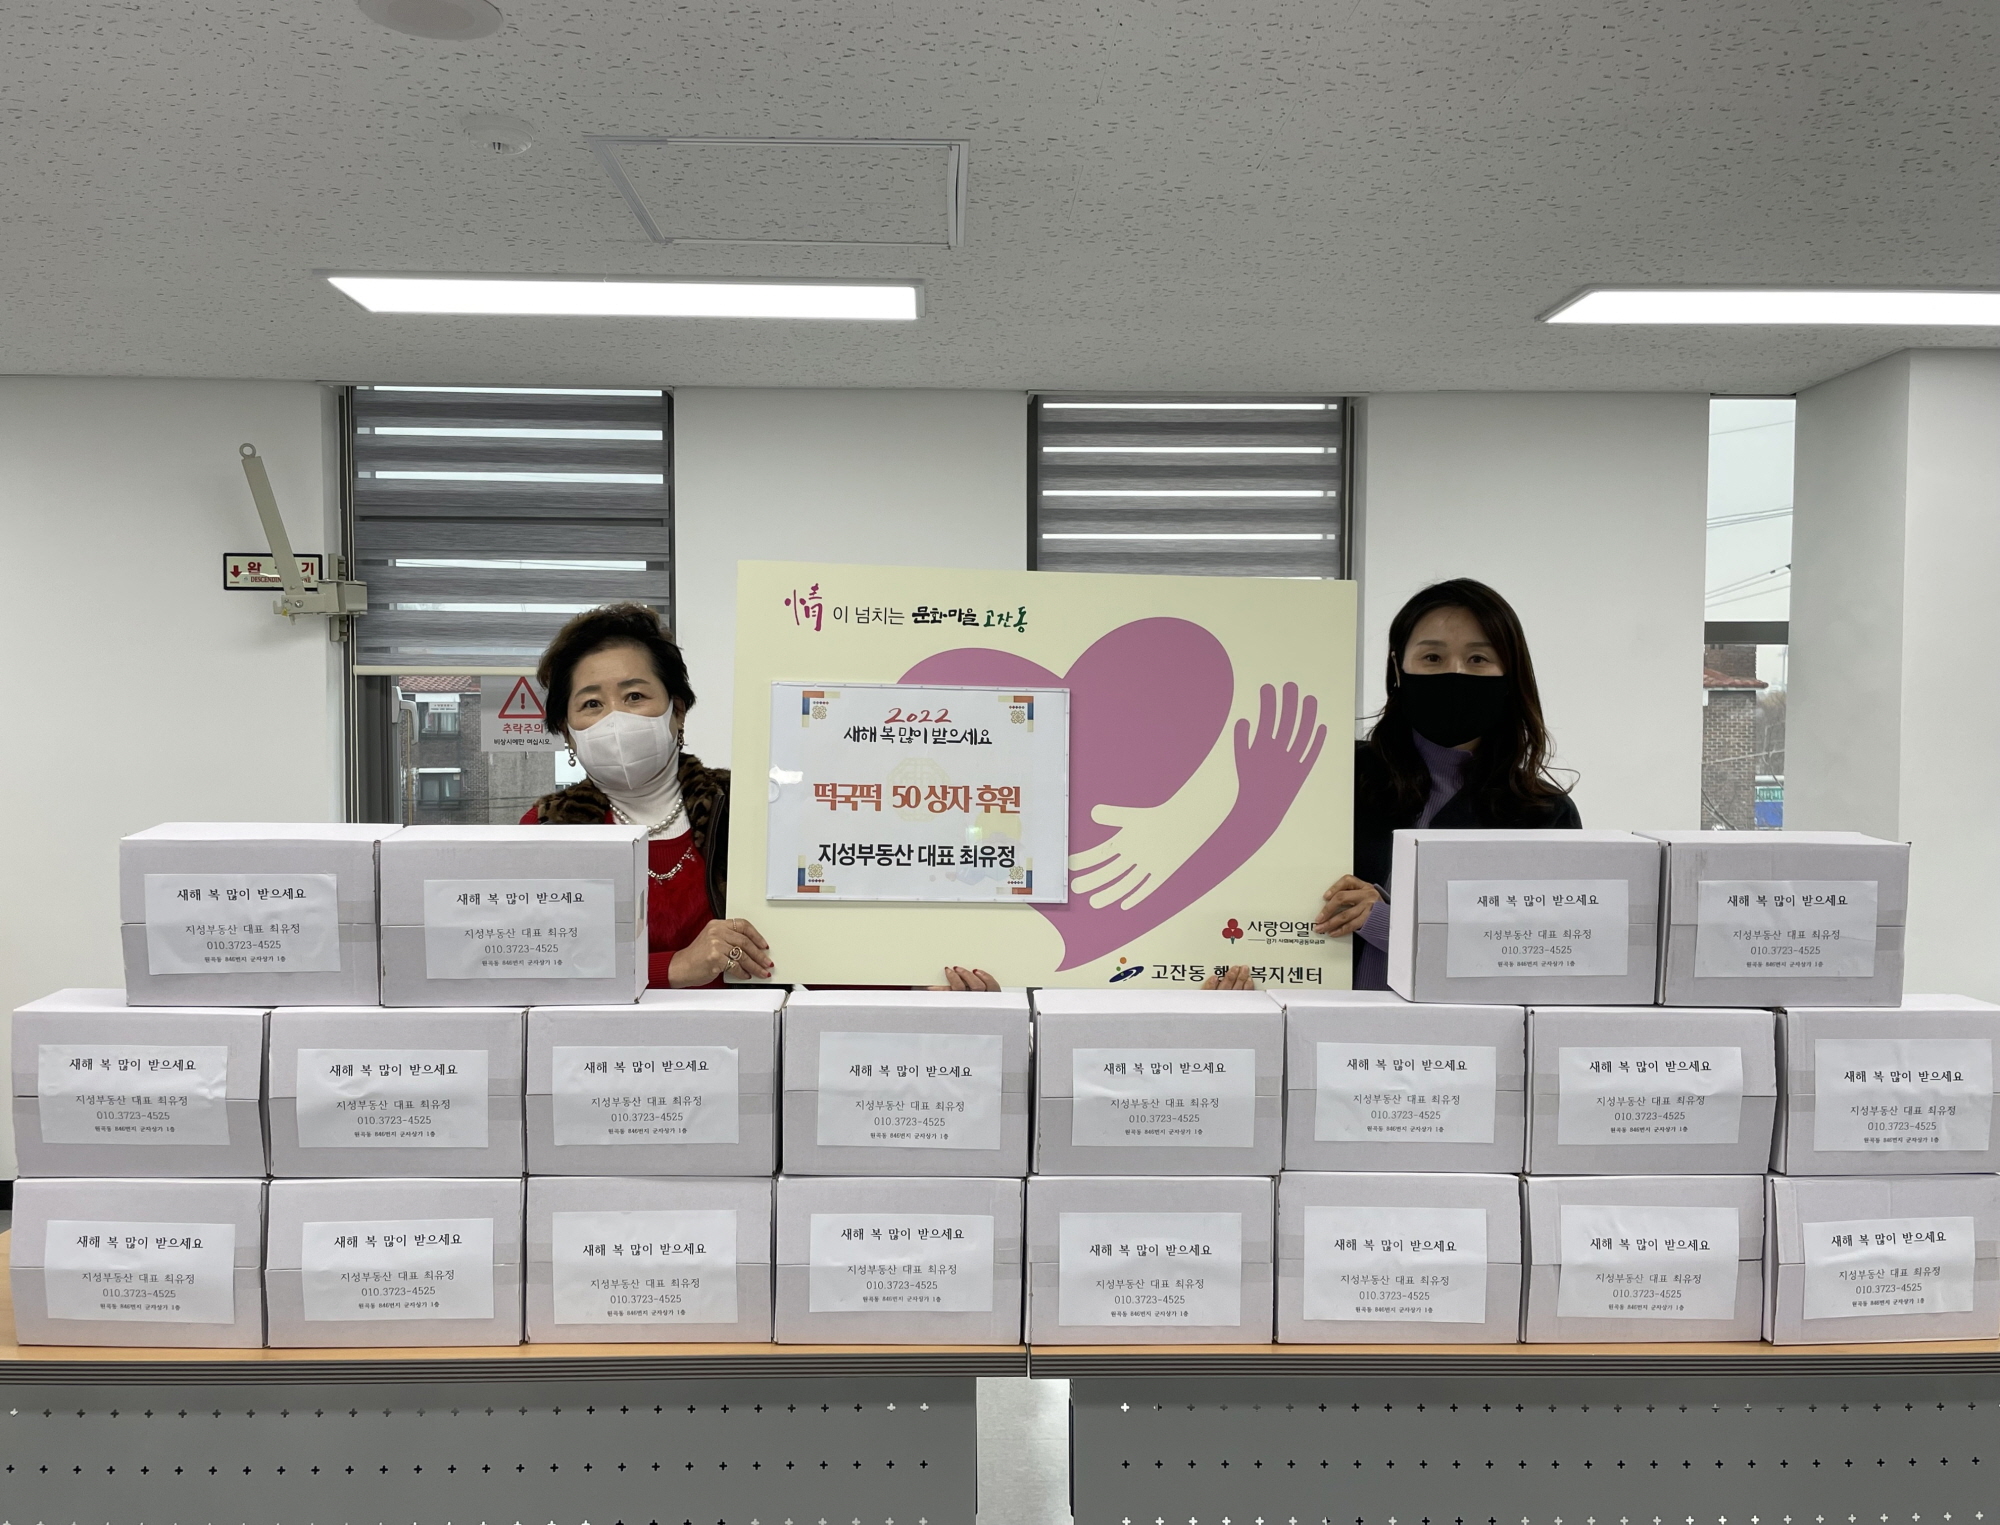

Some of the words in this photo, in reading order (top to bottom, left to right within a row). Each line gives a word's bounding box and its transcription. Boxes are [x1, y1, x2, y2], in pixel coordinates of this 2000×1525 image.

[833, 605, 848, 624] 이
[855, 605, 905, 625] 넘치는
[983, 606, 1028, 633] 고잔동
[884, 707, 953, 724] 2022
[502, 723, 544, 734] 추락주의
[843, 725, 877, 743] 새해
[880, 726, 896, 744] 복
[898, 727, 928, 745] 많이
[931, 727, 993, 746] 받으세요
[493, 738, 525, 746] 비상시에만
[813, 783, 882, 812] 떡국떡
[892, 785, 921, 809] 50
[924, 784, 972, 813] 상자
[975, 785, 1021, 814] 후원
[818, 842, 914, 867] 지성부동산
[918, 845, 955, 867] 대표
[959, 845, 1015, 868] 최유정
[176, 888, 201, 902] 새해
[207, 888, 221, 901] 복
[226, 888, 250, 901] 많이
[257, 887, 307, 901] 받으세요
[1727, 894, 1749, 907] 새해
[1755, 895, 1768, 907] 복
[1774, 894, 1795, 907] 많이
[1802, 894, 1848, 907] 받으세요
[1477, 895, 1500, 908] 새해
[1506, 895, 1518, 907] 복
[1523, 894, 1546, 907] 많이
[1552, 894, 1599, 907] 받으세요
[185, 924, 238, 936] 지성부동산
[243, 923, 264, 934] 대표
[270, 923, 300, 935] 최유정
[464, 928, 516, 940] 지성부동산
[521, 927, 542, 938] 대표
[548, 927, 577, 938] 최유정
[1483, 929, 1533, 941] 지성부동산
[1538, 929, 1558, 940] 대표
[1563, 929, 1591, 940] 최유정
[206, 940, 281, 950] 010.3723-4525
[484, 943, 559, 954] 010.3723-4525
[1501, 945, 1572, 955] 010.3723-4525
[1750, 946, 1821, 955] 010.3723-4525
[1151, 964, 1206, 983] 고잔동
[1213, 965, 1323, 985] 행복지센터
[329, 1064, 353, 1077] 새해
[360, 1064, 373, 1077] 복
[379, 1063, 402, 1077] 많이
[409, 1063, 458, 1076] 받으세요
[583, 1061, 607, 1074] 새해
[613, 1061, 626, 1074] 복
[632, 1060, 655, 1073] 많이
[661, 1059, 709, 1073] 받으세요
[1346, 1058, 1369, 1071] 새해
[1375, 1058, 1387, 1071] 복
[1393, 1058, 1415, 1071] 많이
[1421, 1059, 1468, 1072] 받으세요
[1844, 1070, 1867, 1083] 새해
[1873, 1070, 1885, 1083] 복
[1890, 1070, 1912, 1083] 많이
[1918, 1070, 1964, 1083] 받으세요
[76, 1094, 126, 1106] 지성부동산
[131, 1095, 153, 1106] 대표
[158, 1095, 187, 1106] 최유정
[336, 1100, 388, 1111] 지성부동산
[394, 1100, 415, 1110] 대표
[420, 1099, 450, 1110] 최유정
[855, 1100, 905, 1111] 지성부동산
[910, 1100, 930, 1111] 대표
[935, 1100, 964, 1112] 최유정
[1110, 1098, 1160, 1110] 지성부동산
[1165, 1098, 1185, 1108] 대표
[1190, 1097, 1219, 1108] 최유정
[1596, 1096, 1646, 1107] 지성부동산
[1651, 1096, 1671, 1106] 대표
[1676, 1095, 1705, 1106] 최유정
[96, 1111, 170, 1120] 010.3723-4525
[357, 1115, 432, 1125] 010.3723-4525
[611, 1112, 683, 1122] 010.3723-4525
[1129, 1114, 1200, 1123] 010.3723-4525
[1371, 1110, 1441, 1120] 010.3723-4525
[1614, 1111, 1685, 1121] 010.3723-4525
[874, 1116, 946, 1127] 010.3723-4525
[1867, 1121, 1937, 1131] 010.3723-4525
[333, 1235, 358, 1249] 새해
[365, 1235, 378, 1248] 복
[383, 1234, 407, 1248] 많이
[414, 1233, 463, 1247] 받으세요
[1831, 1234, 1853, 1248] 새해
[1858, 1233, 1870, 1247] 복
[1874, 1232, 1896, 1246] 많이
[1902, 1230, 1947, 1245] 받으세요
[582, 1243, 606, 1257] 새해
[612, 1243, 624, 1256] 복
[630, 1243, 653, 1256] 많이
[659, 1242, 707, 1256] 받으세요
[1089, 1244, 1112, 1257] 새해
[1118, 1244, 1131, 1257] 복
[1136, 1244, 1159, 1257] 많이
[1165, 1244, 1212, 1257] 받으세요
[847, 1264, 897, 1276] 지성부동산
[902, 1264, 922, 1275] 대표
[928, 1264, 957, 1275] 최유정
[82, 1272, 133, 1283] 지성부동산
[138, 1273, 159, 1283] 대표
[165, 1273, 195, 1284] 최유정
[341, 1271, 392, 1283] 지성부동산
[398, 1270, 419, 1281] 대표
[424, 1270, 454, 1281] 최유정
[1340, 1274, 1390, 1286] 지성부동산
[1395, 1275, 1415, 1285] 대표
[1420, 1275, 1449, 1286] 최유정
[1596, 1273, 1644, 1284] 지성부동산
[1649, 1274, 1668, 1284] 대표
[1673, 1274, 1702, 1284] 최유정
[866, 1280, 938, 1290] 010.3723-4525
[1855, 1283, 1922, 1294] 010.3723-4525
[102, 1288, 176, 1298] 010.3723-4525
[361, 1286, 436, 1297] 010.3723-4525
[1359, 1291, 1430, 1301] 010.3723-4525
[1612, 1289, 1682, 1299] 010.3723-4525
[610, 1294, 682, 1304] 010.3723-4525
[1114, 1295, 1185, 1304] 010.3723-4525
